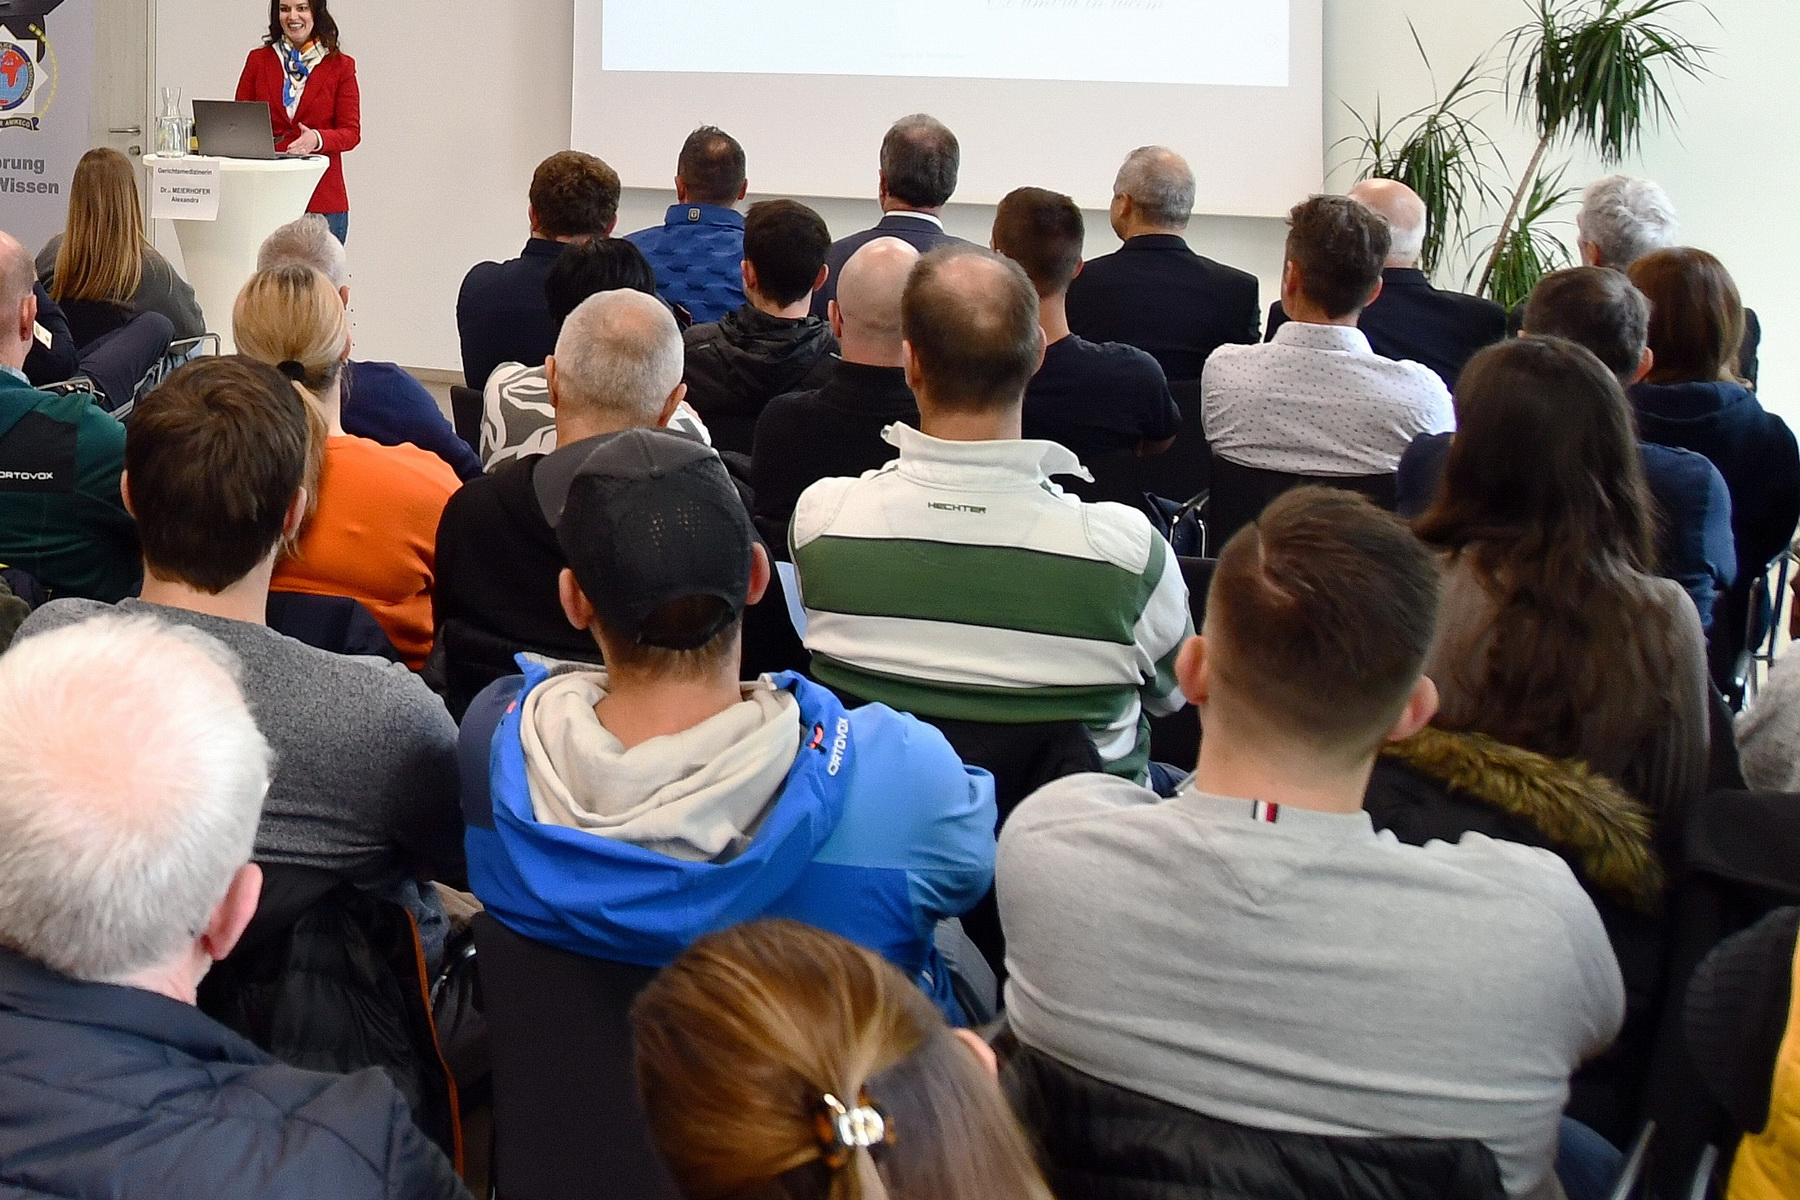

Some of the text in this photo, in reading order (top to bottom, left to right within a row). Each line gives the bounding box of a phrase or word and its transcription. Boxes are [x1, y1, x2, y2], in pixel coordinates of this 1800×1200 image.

[157, 167, 213, 175] Gerichtsmedizinerin
[172, 187, 211, 195] MEIERHOFER
[927, 502, 987, 514] HECHTER
[826, 716, 849, 777] ORTOVOX
